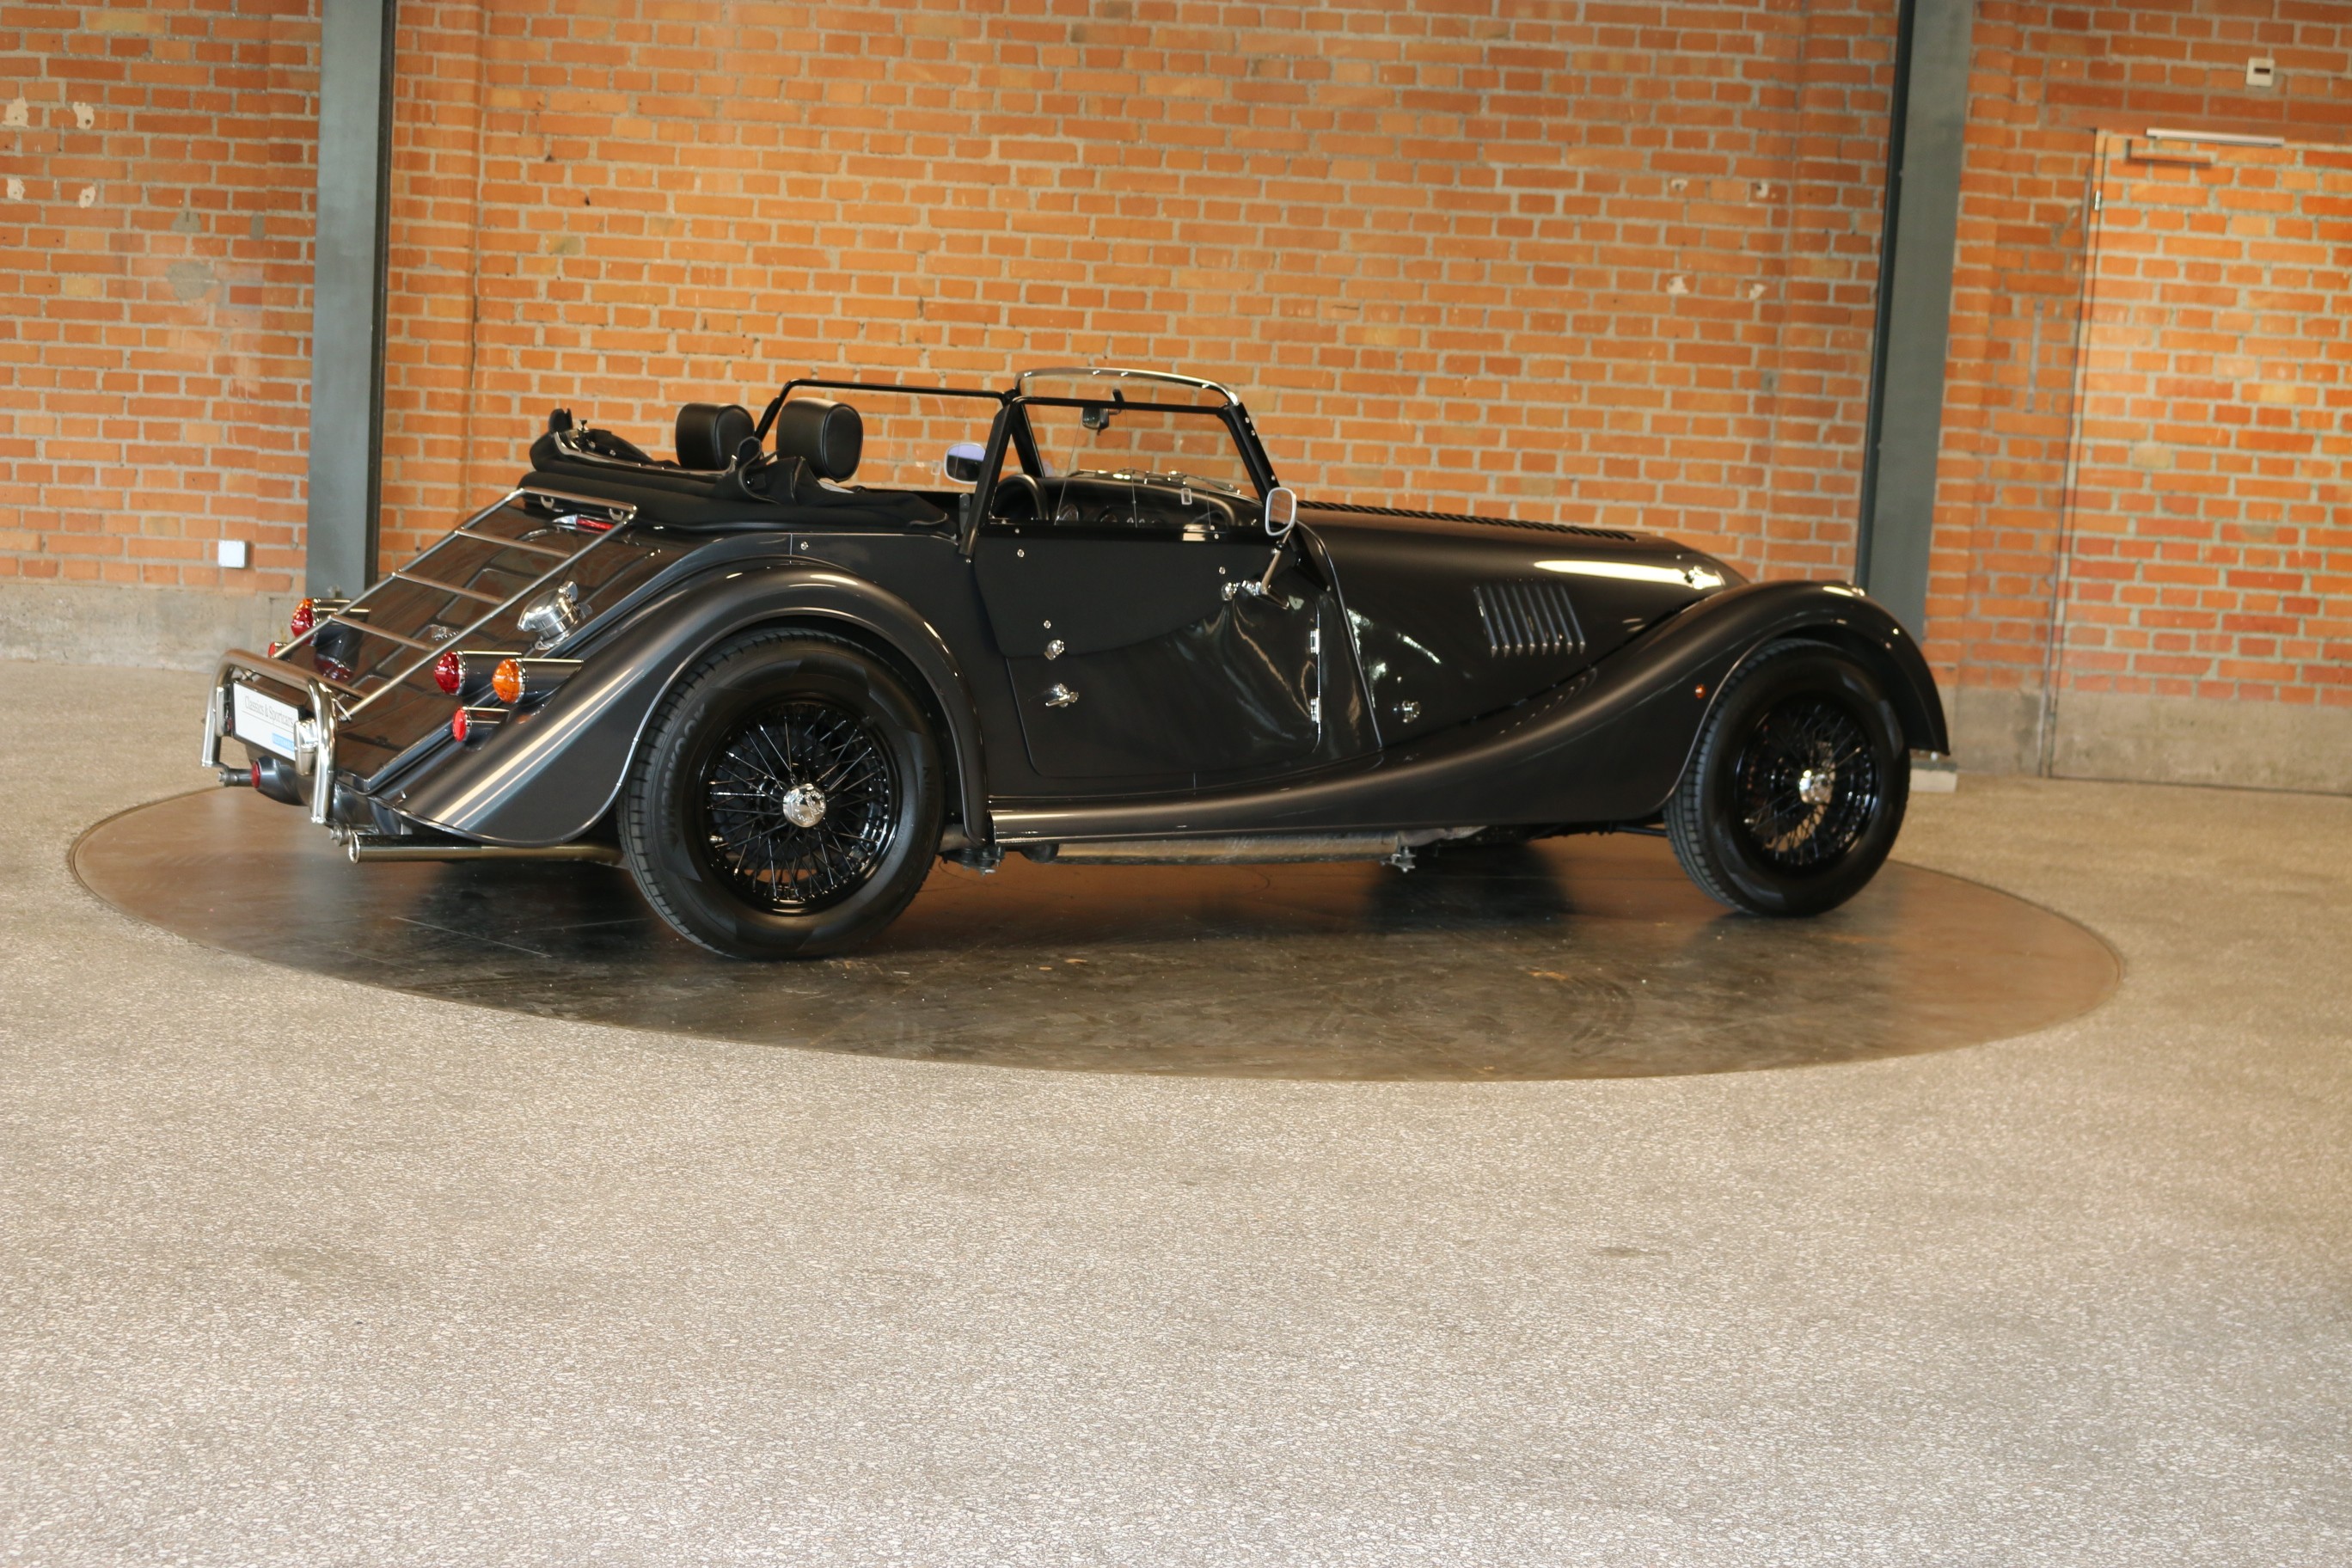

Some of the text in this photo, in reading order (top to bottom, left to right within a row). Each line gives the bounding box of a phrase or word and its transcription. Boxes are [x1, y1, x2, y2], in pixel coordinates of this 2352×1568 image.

[245, 695, 294, 728] Classics & Sportcars
